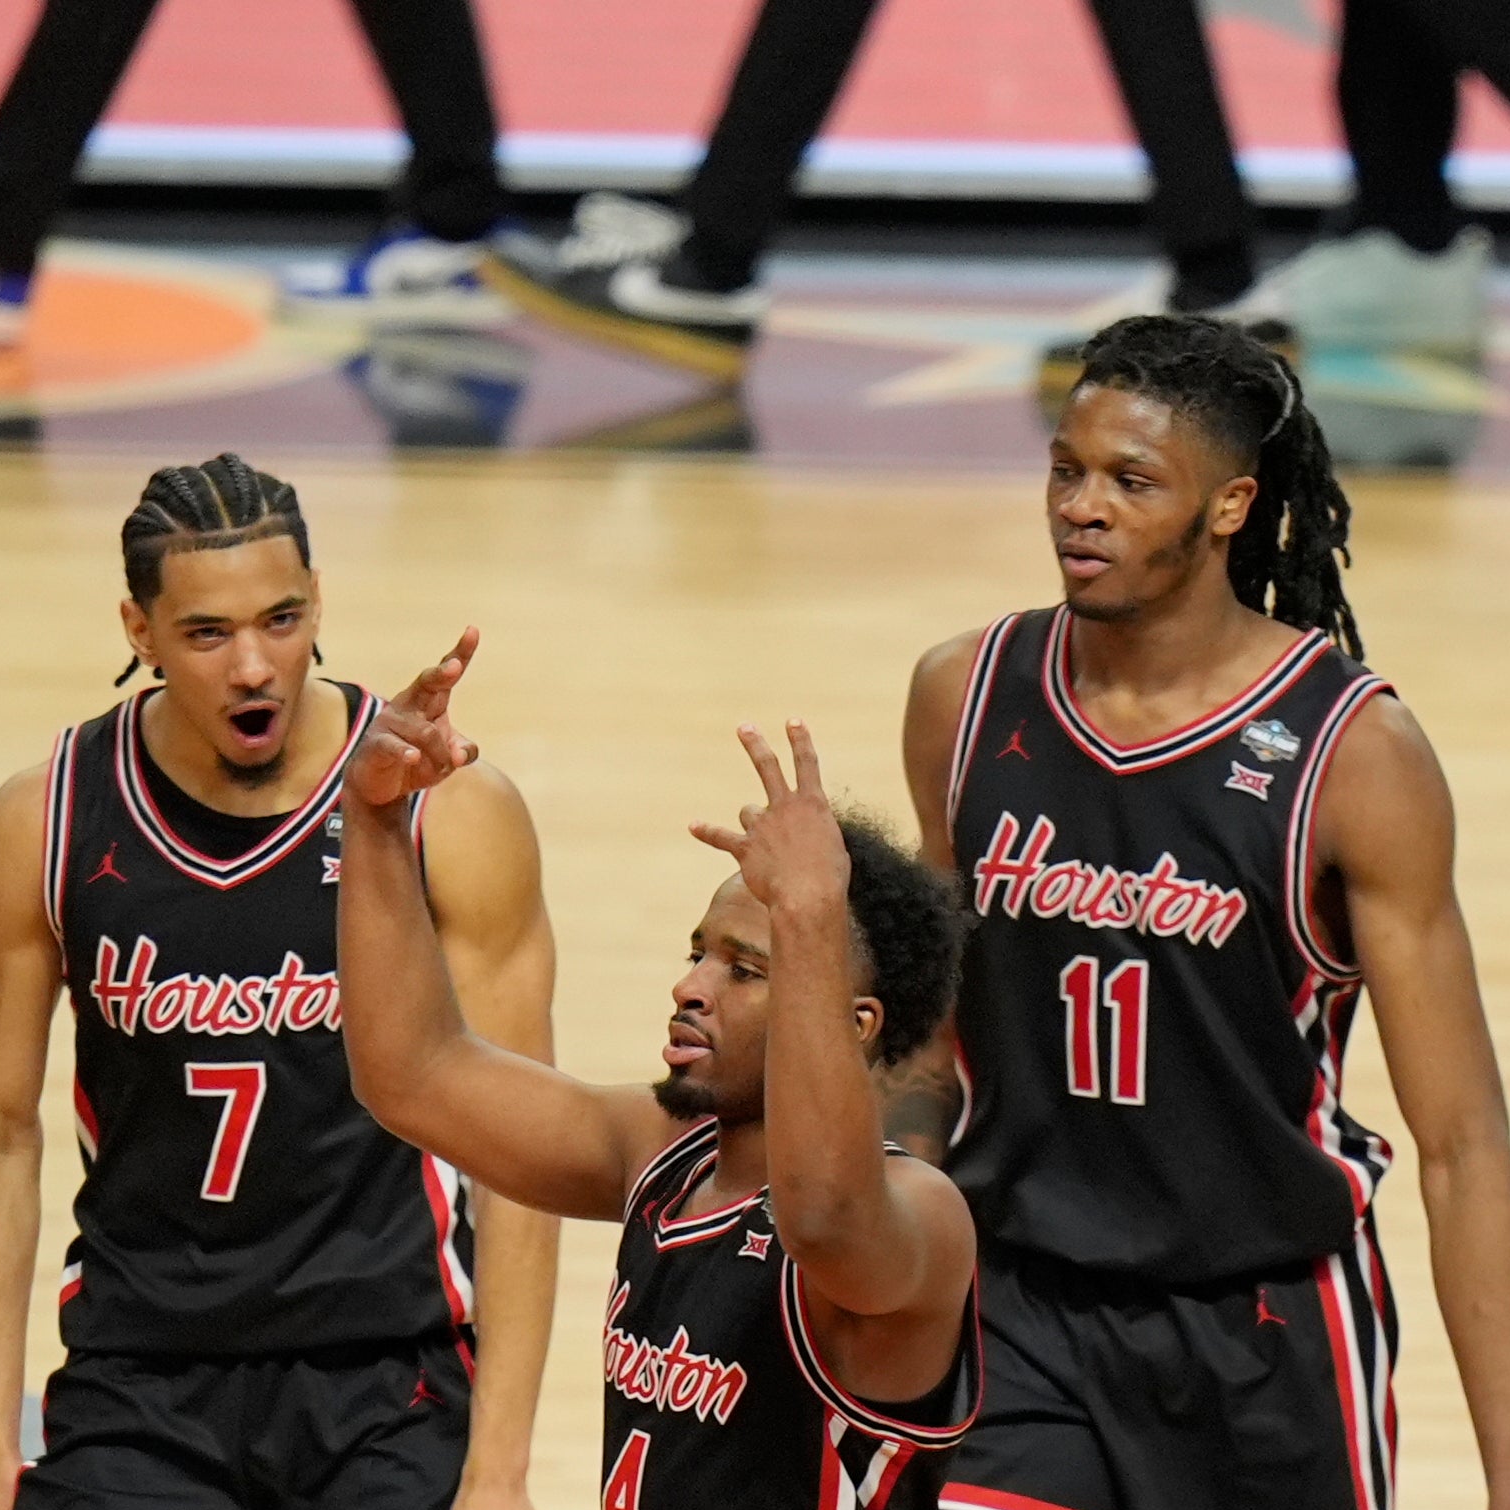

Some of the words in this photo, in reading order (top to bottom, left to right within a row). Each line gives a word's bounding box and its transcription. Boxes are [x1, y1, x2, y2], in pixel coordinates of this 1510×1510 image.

[974, 810, 1248, 950] Houston
[89, 934, 342, 1037] Housto
[1059, 955, 1150, 1106] 11
[185, 1061, 267, 1203] 7
